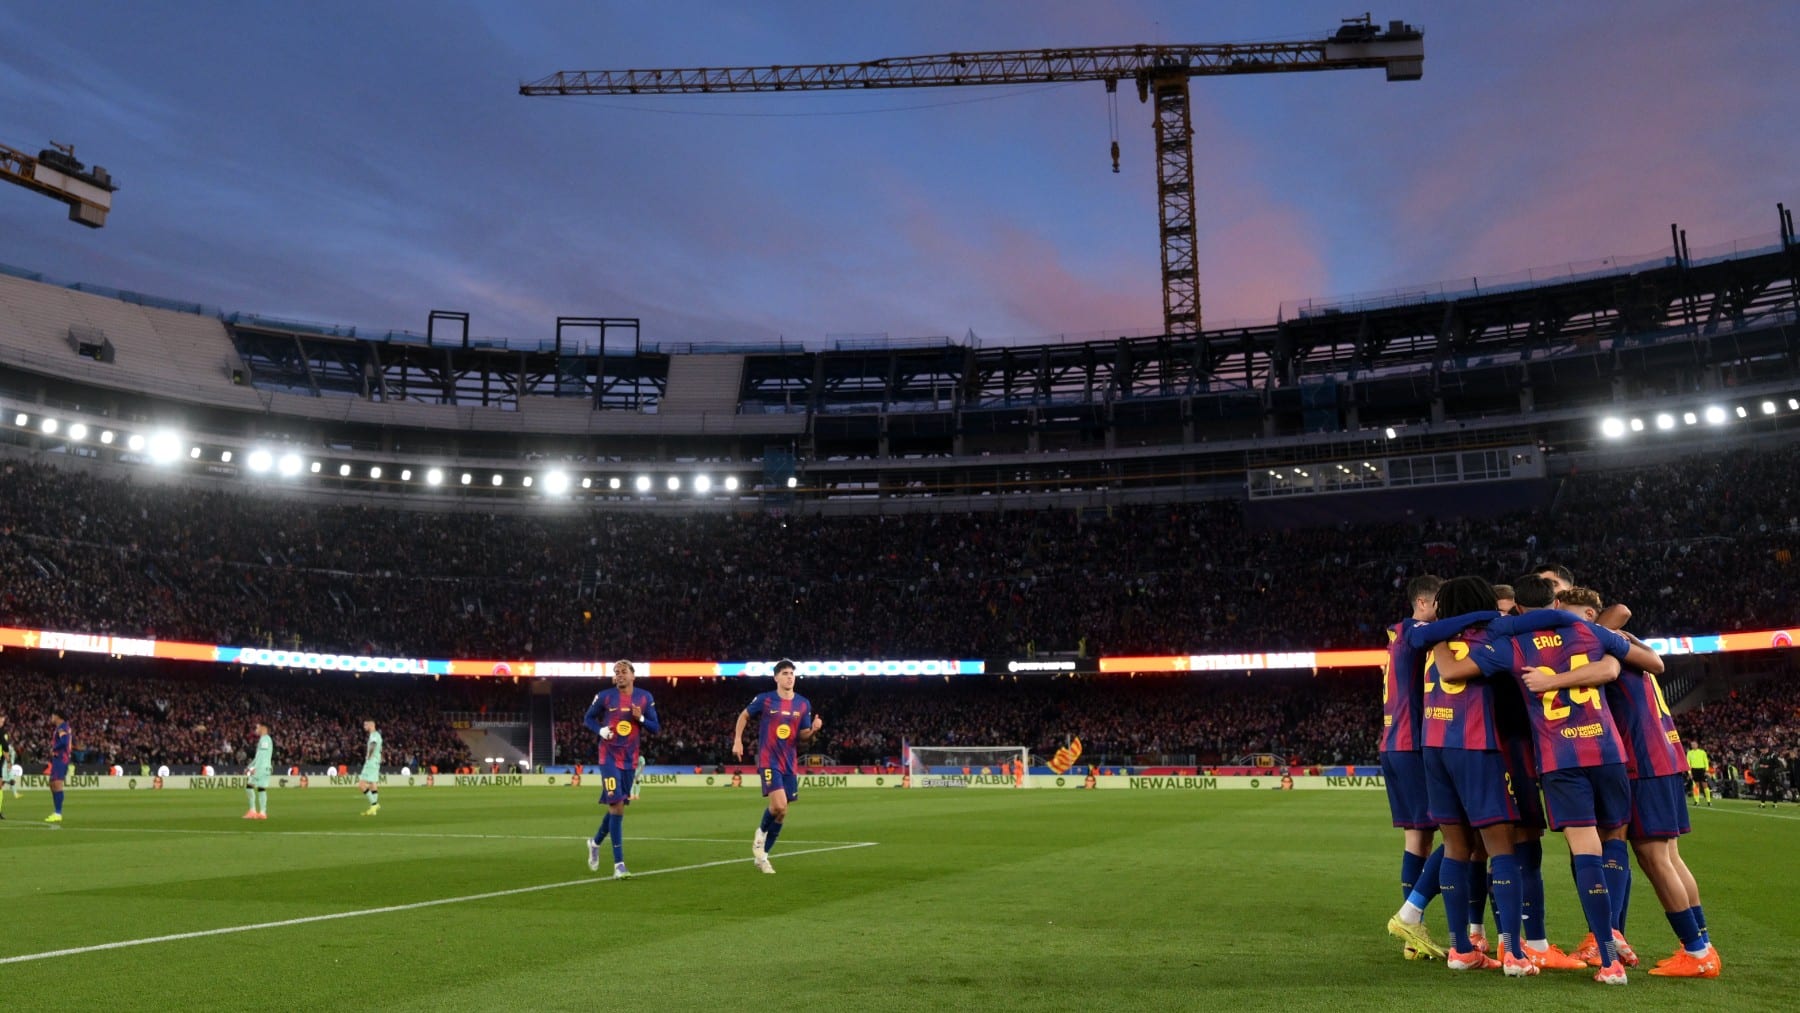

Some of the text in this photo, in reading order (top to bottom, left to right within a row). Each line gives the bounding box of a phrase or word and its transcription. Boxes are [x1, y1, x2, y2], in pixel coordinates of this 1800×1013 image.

[1532, 634, 1563, 650] ERIC
[1536, 653, 1602, 721] 24
[20, 775, 100, 787] NEW LBUM
[330, 776, 353, 785] NEW
[455, 776, 522, 786] NEW ALBUM
[764, 769, 773, 781] 5
[802, 775, 848, 787] ALBUM
[190, 777, 249, 789] NEW ALBU
[603, 777, 617, 791] 10
[1129, 777, 1217, 789] NEW ALBUM
[1326, 776, 1362, 787] NEW
